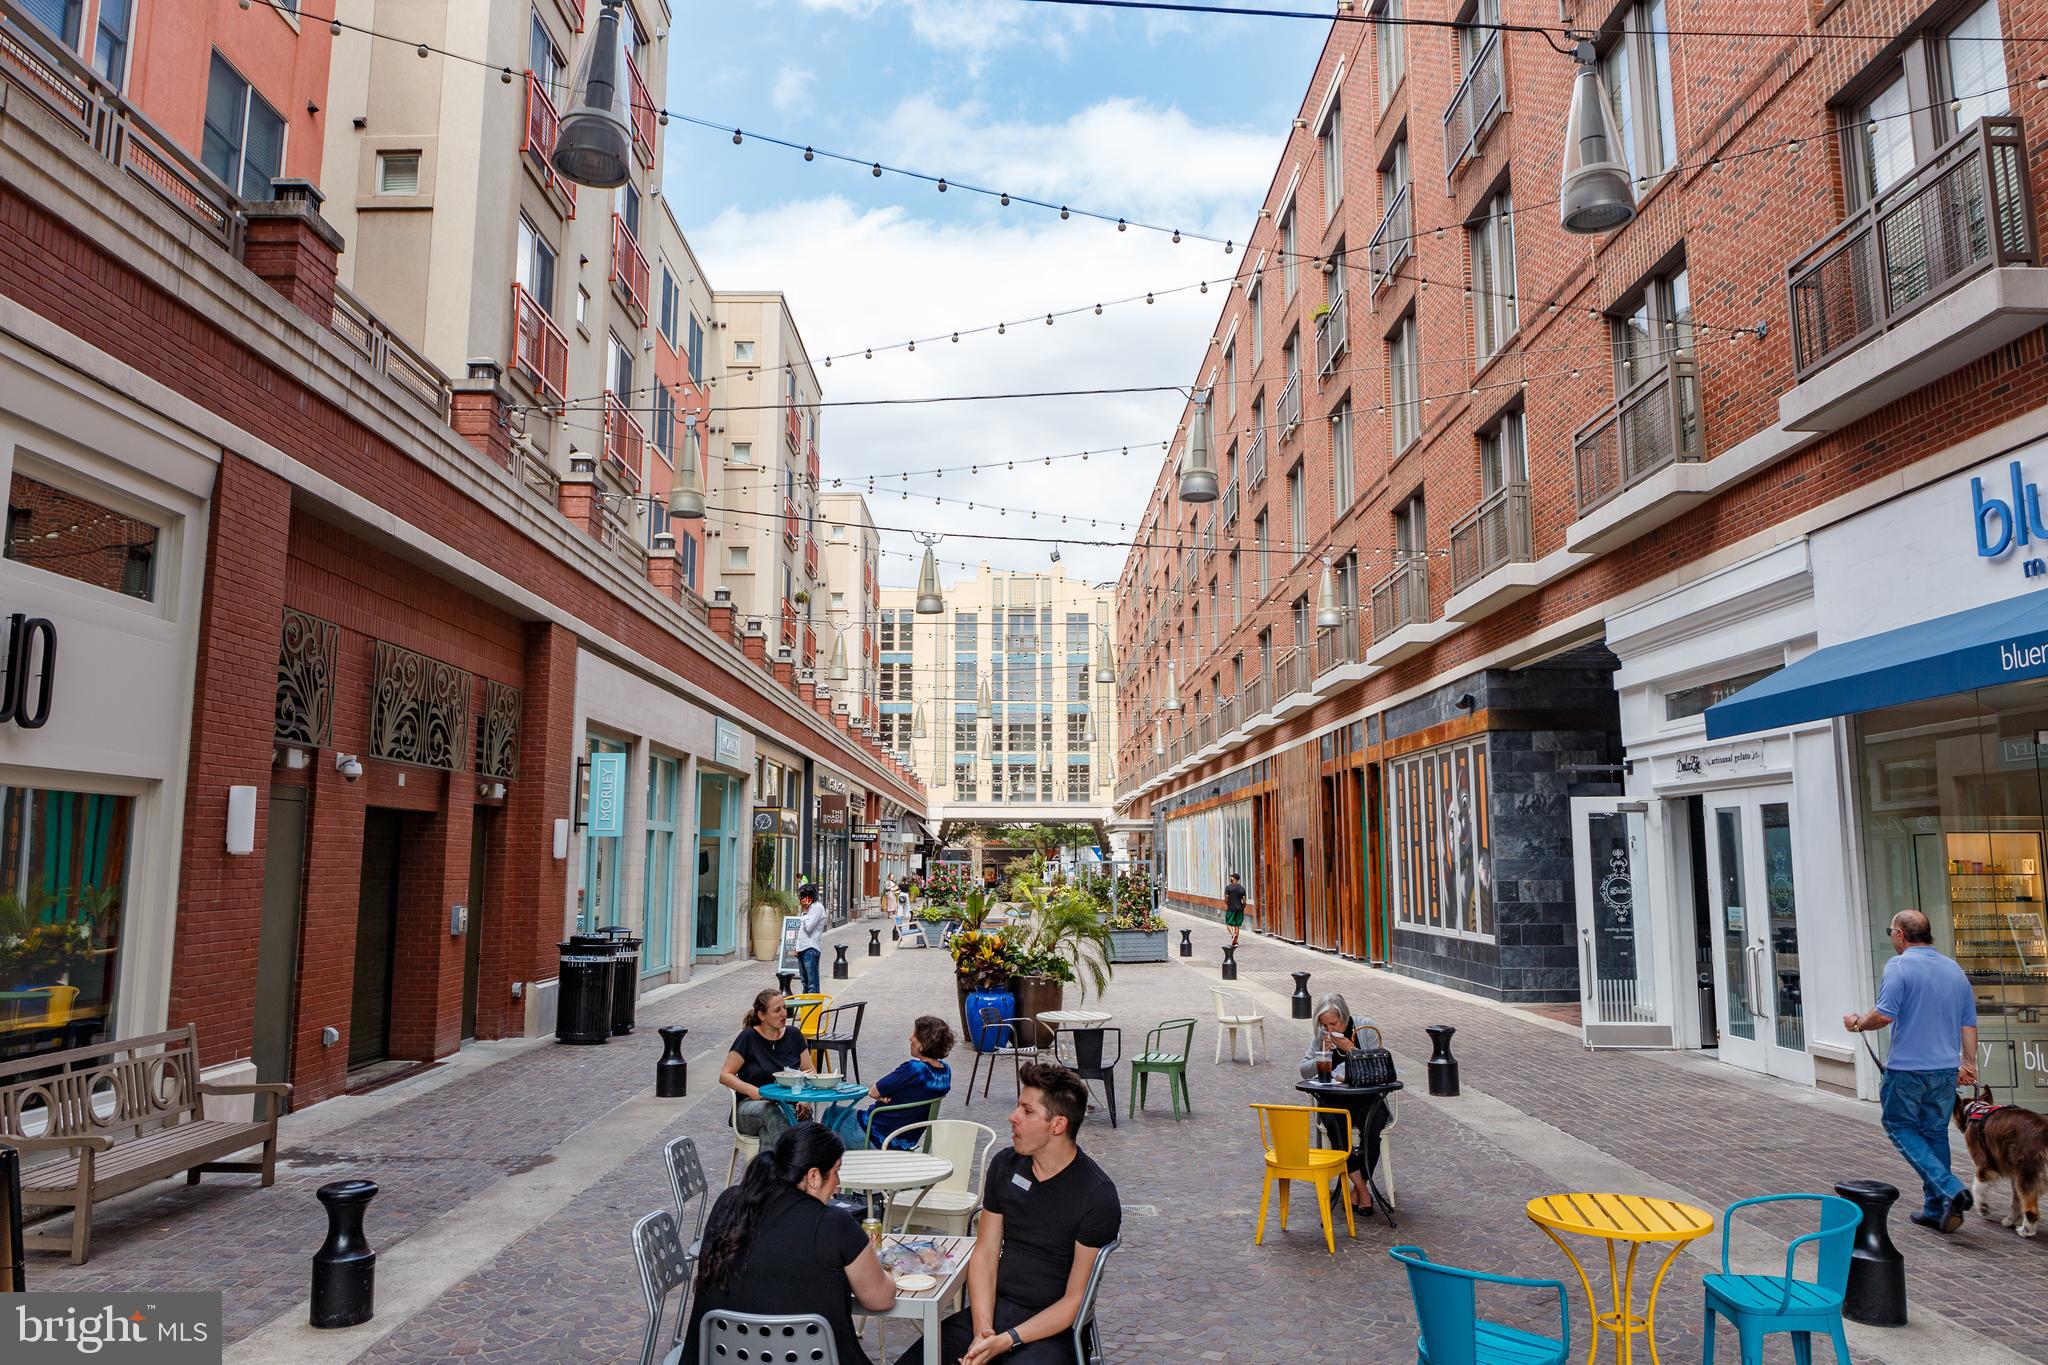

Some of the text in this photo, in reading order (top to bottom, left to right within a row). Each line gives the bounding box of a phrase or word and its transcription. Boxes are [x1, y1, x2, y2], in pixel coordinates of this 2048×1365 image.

[1711, 754, 1733, 765] artisanal
[1734, 752, 1751, 763] gelato
[600, 767, 614, 822] MORLEY
